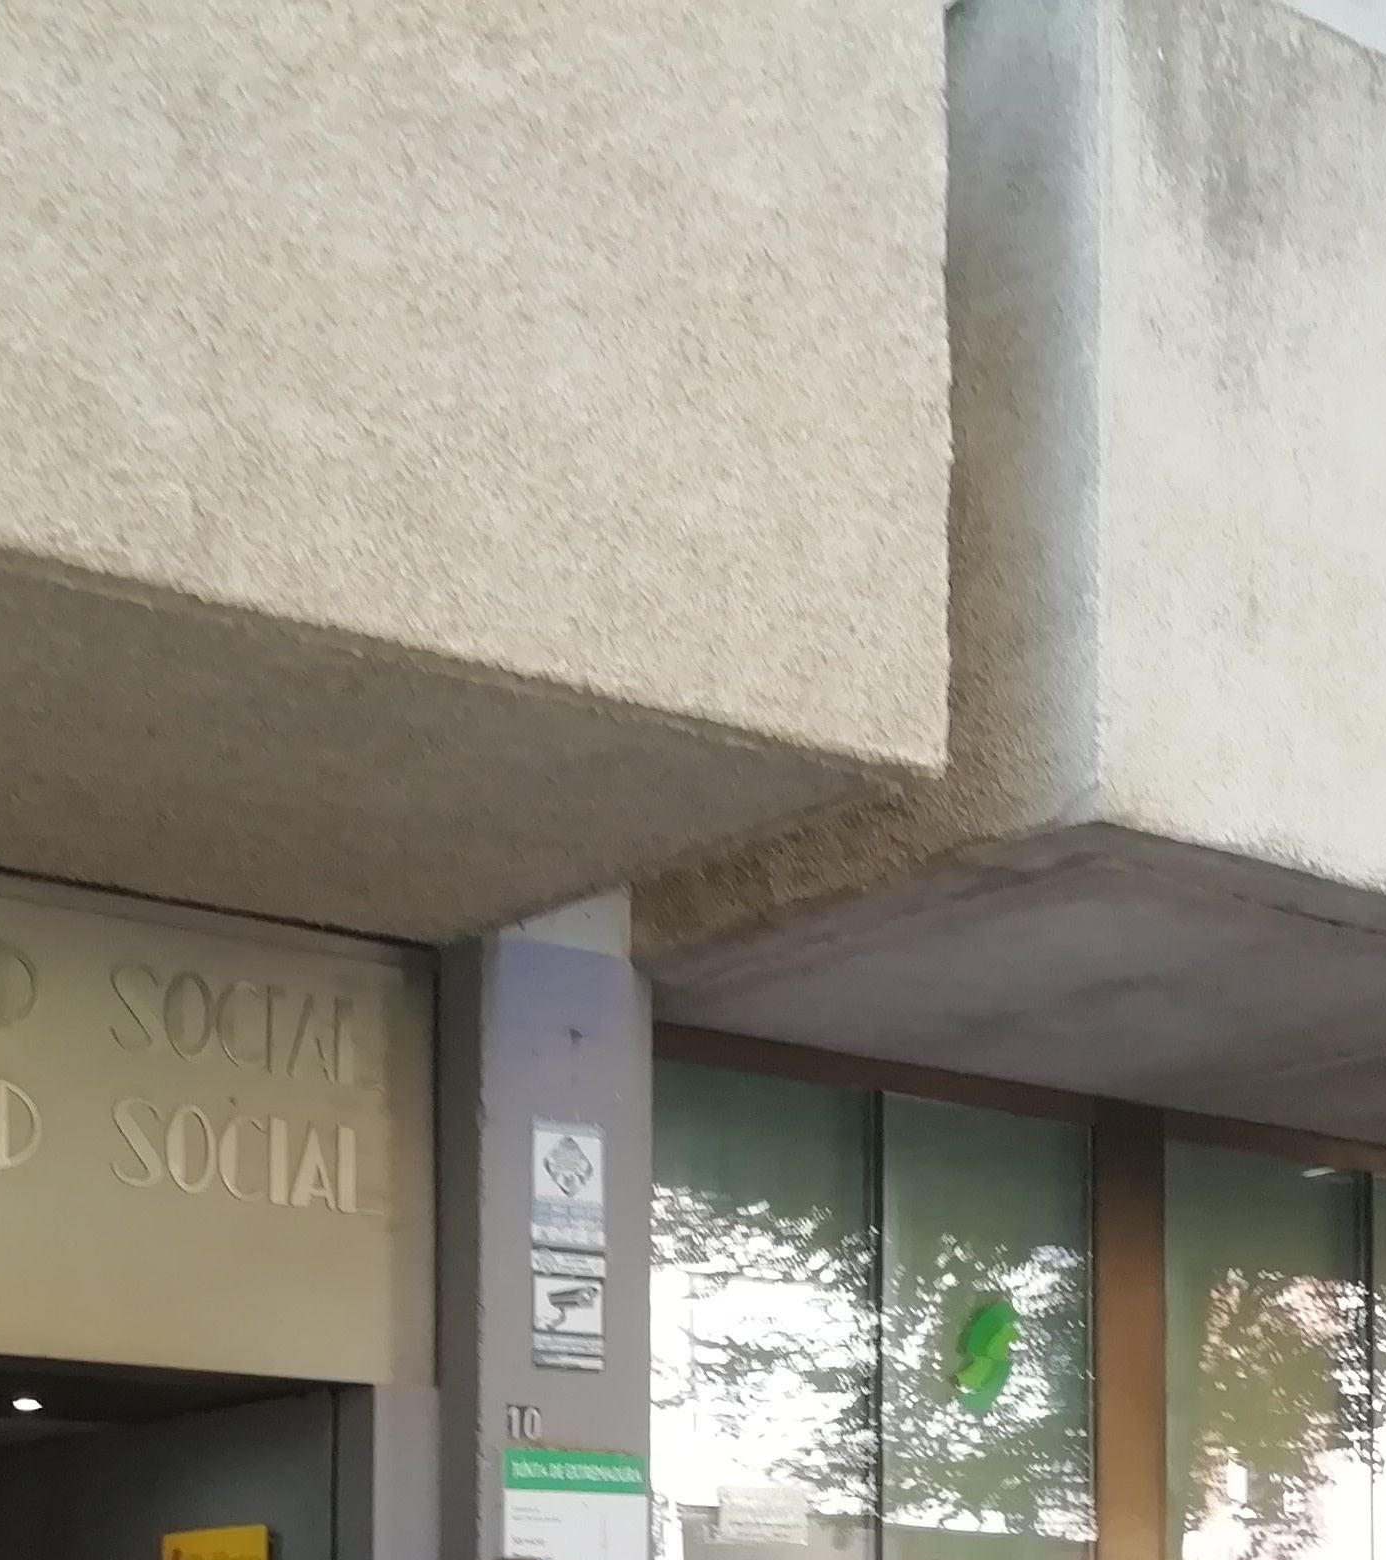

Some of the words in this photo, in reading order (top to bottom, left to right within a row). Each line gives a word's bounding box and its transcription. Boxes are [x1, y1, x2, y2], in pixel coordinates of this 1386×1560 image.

[109, 961, 387, 1093] SOCIAL
[110, 1097, 387, 1215] SOCIAL
[507, 1404, 542, 1441] 10
